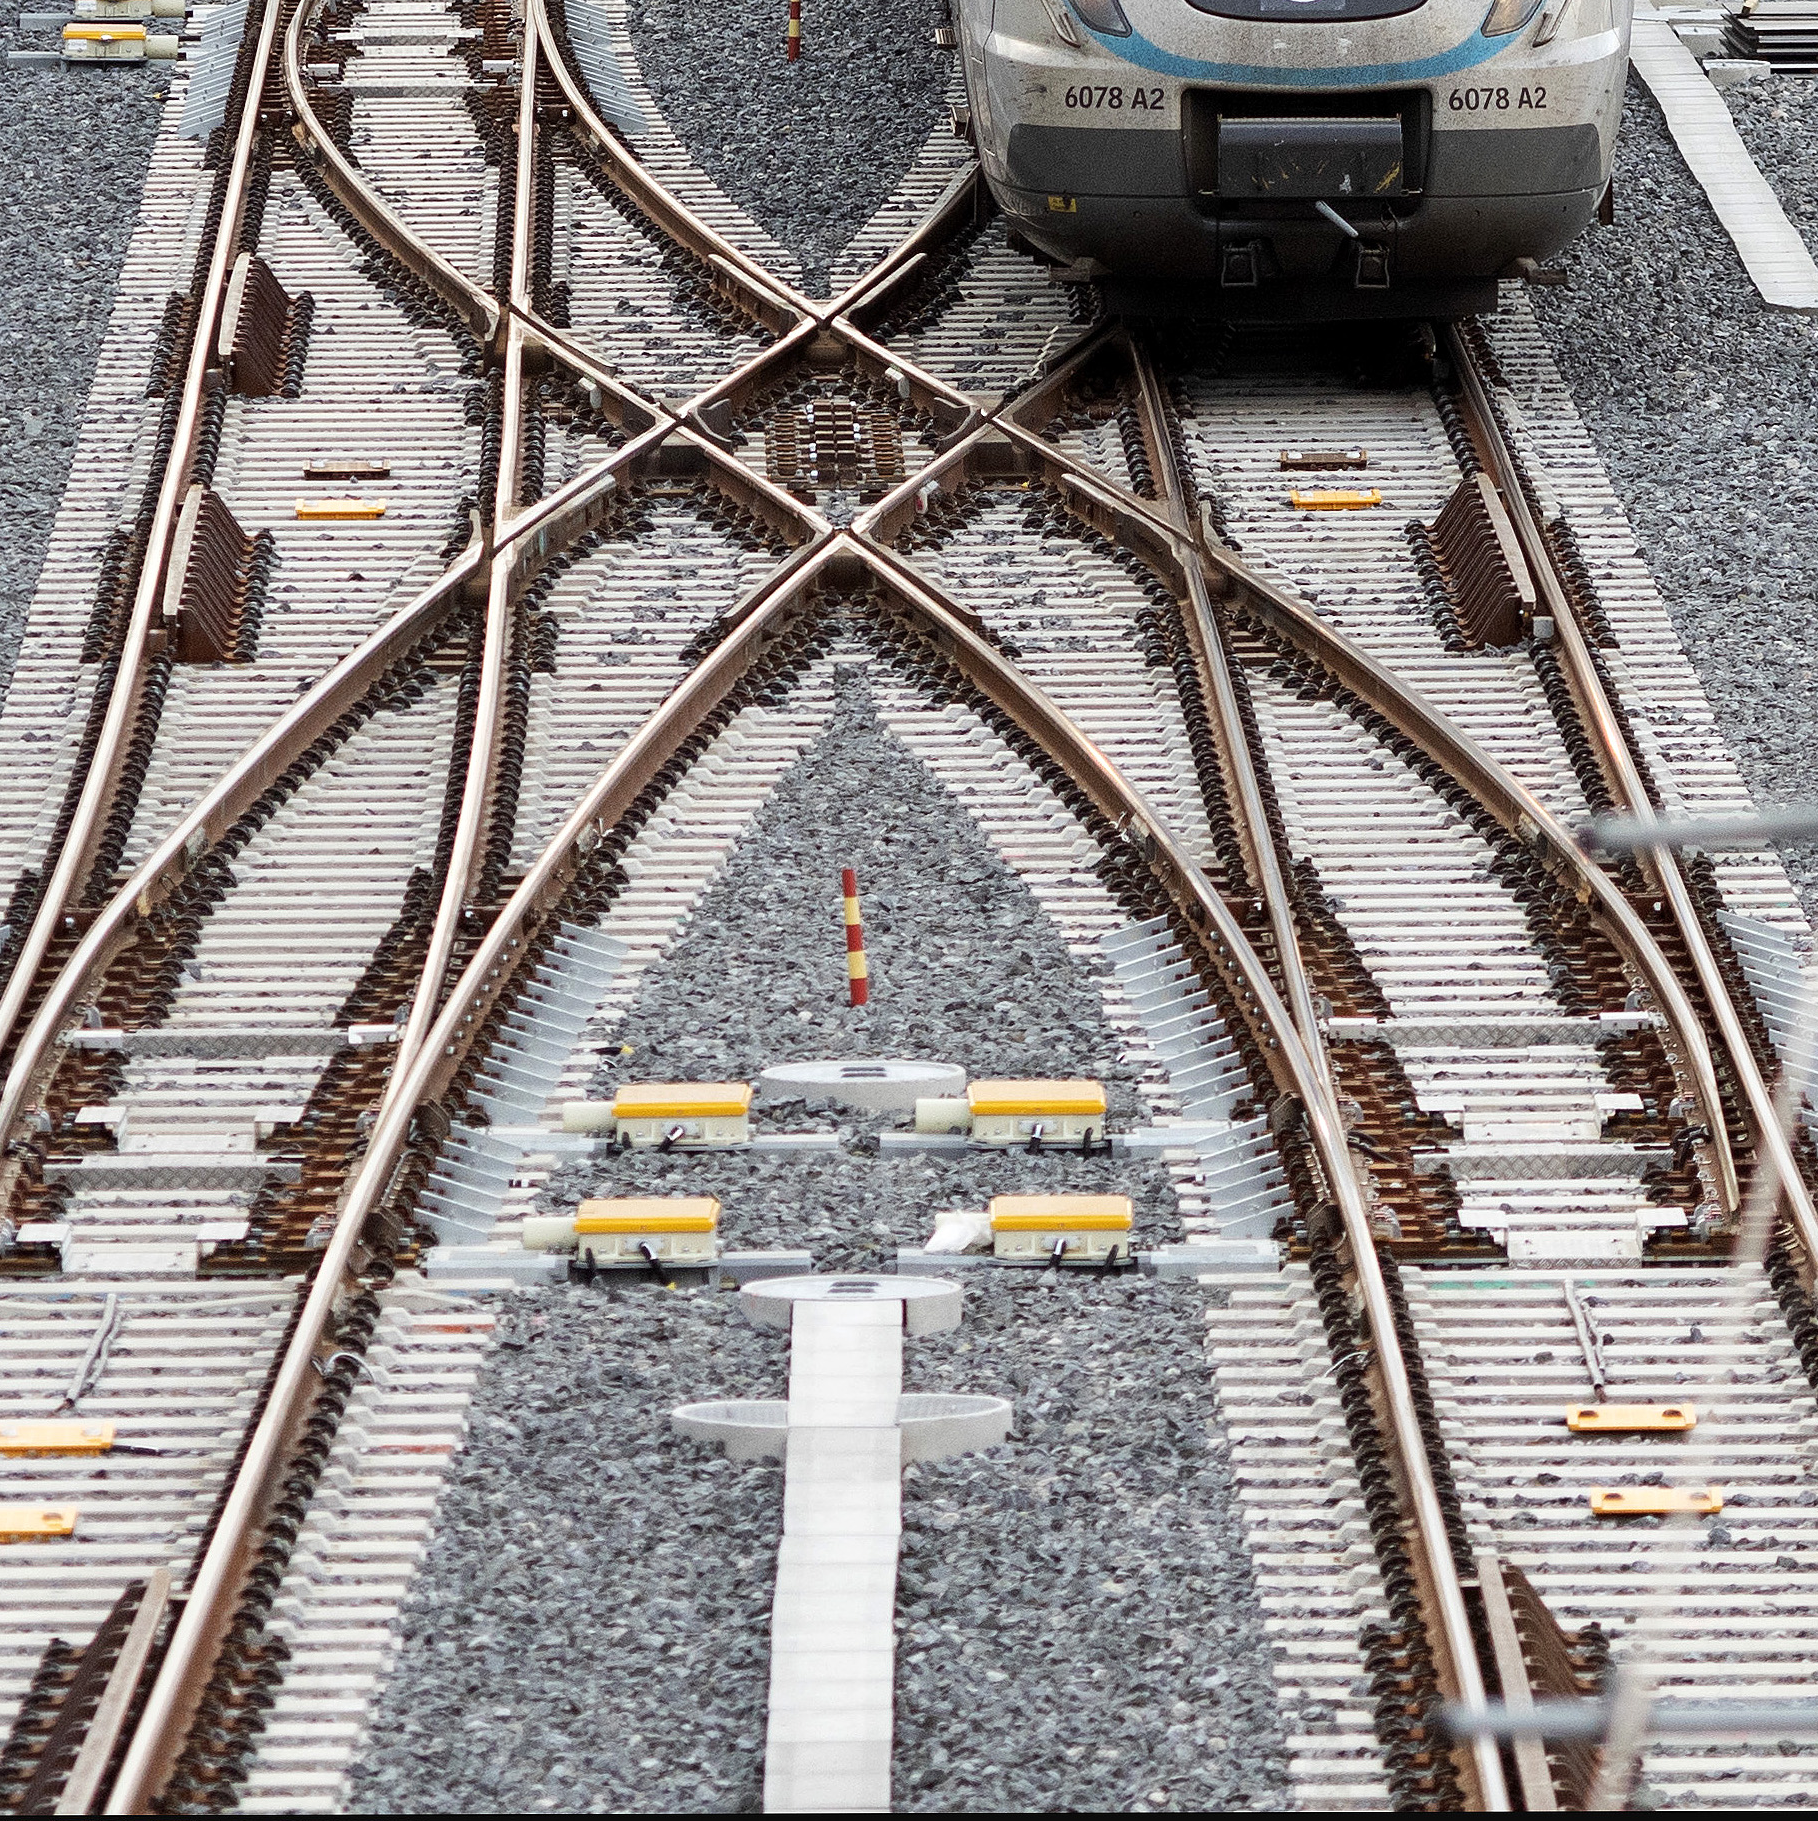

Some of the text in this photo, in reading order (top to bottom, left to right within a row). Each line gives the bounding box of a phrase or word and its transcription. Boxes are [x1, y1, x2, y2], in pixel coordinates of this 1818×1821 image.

[1064, 86, 1165, 110] 6078 A2
[1448, 86, 1547, 111] 6078 A2
